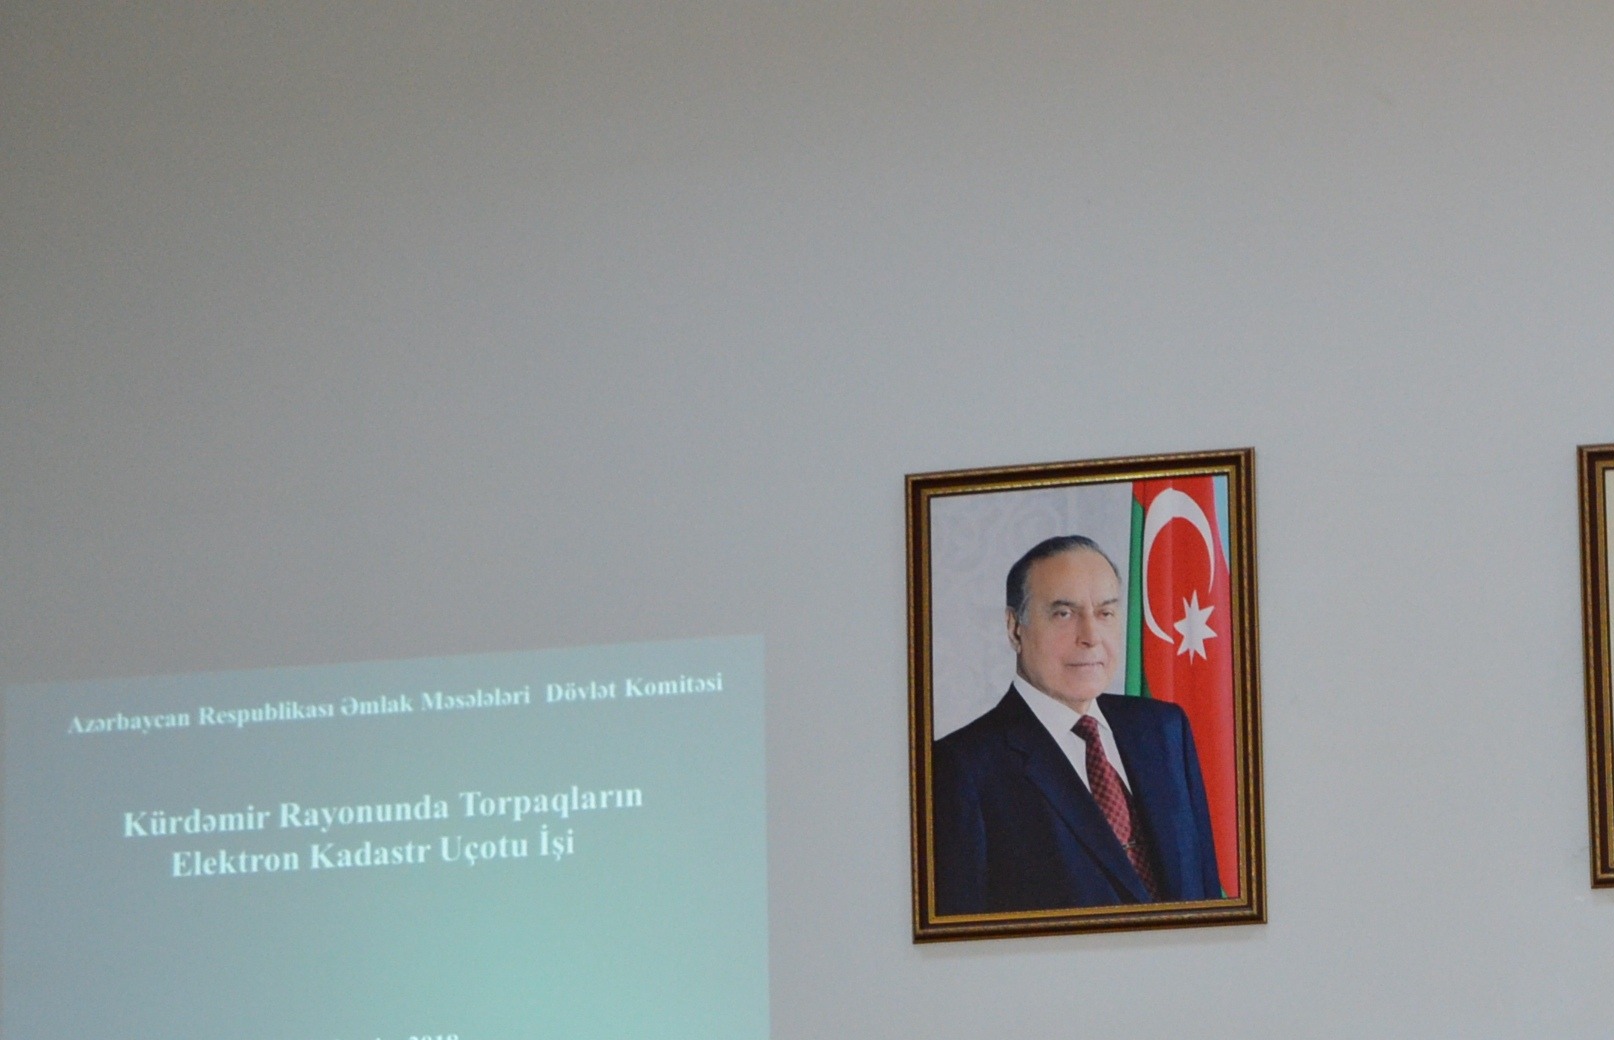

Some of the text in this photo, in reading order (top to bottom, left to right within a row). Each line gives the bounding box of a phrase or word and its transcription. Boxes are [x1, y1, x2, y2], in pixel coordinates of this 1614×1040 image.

[68, 672, 723, 735] Azərbaycan Respublikası Əmlak Məsələləri Dövlət Komitəsi
[124, 785, 643, 837] Kürdəmir Rayonunda Torpaqların
[172, 824, 575, 877] Elektron Kadastr Uçotu İşi
